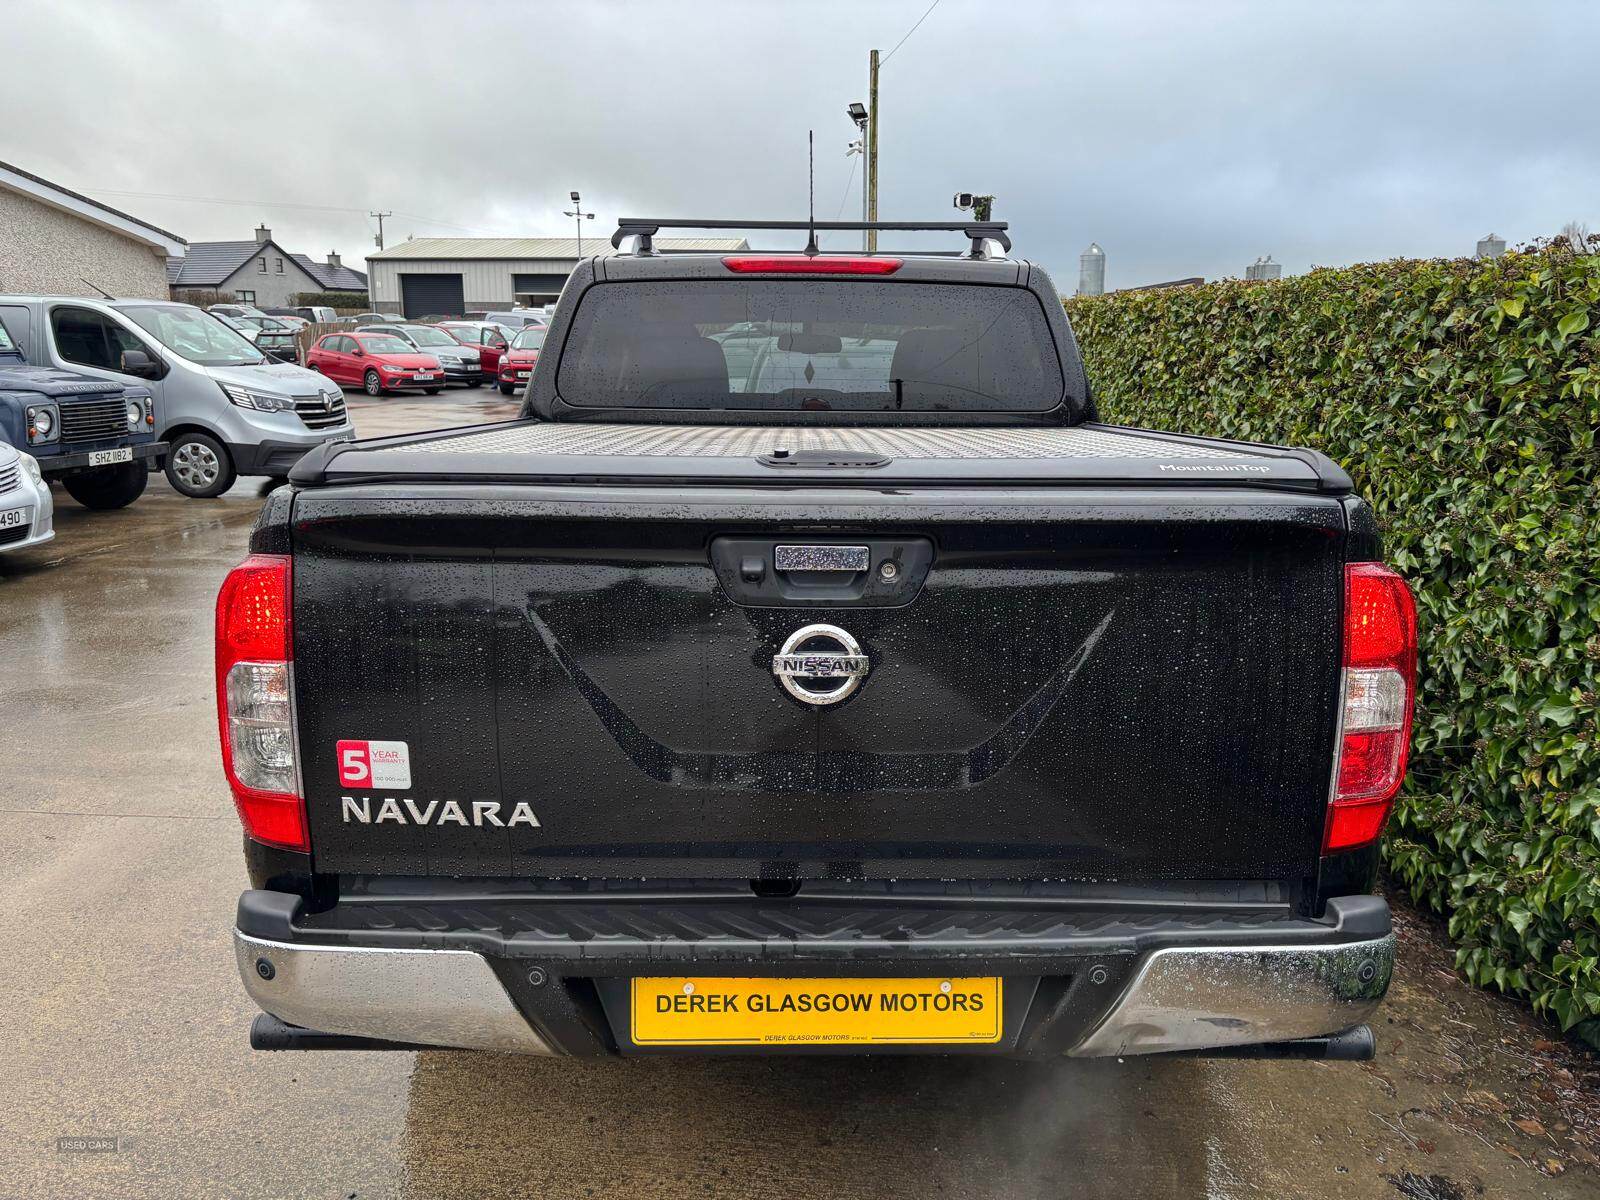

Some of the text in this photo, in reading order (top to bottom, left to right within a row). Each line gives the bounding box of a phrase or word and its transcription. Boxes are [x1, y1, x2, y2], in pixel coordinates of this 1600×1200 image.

[95, 450, 127, 464] SHZ 1182
[1160, 464, 1271, 473] MountainTop
[783, 660, 859, 672] NISSAN
[372, 750, 399, 759] YEAR
[343, 750, 369, 781] 5
[341, 796, 542, 827] NAVARA
[656, 993, 984, 1013] DEREK GLASGOW MOTORS
[764, 1034, 787, 1042] DEREK
